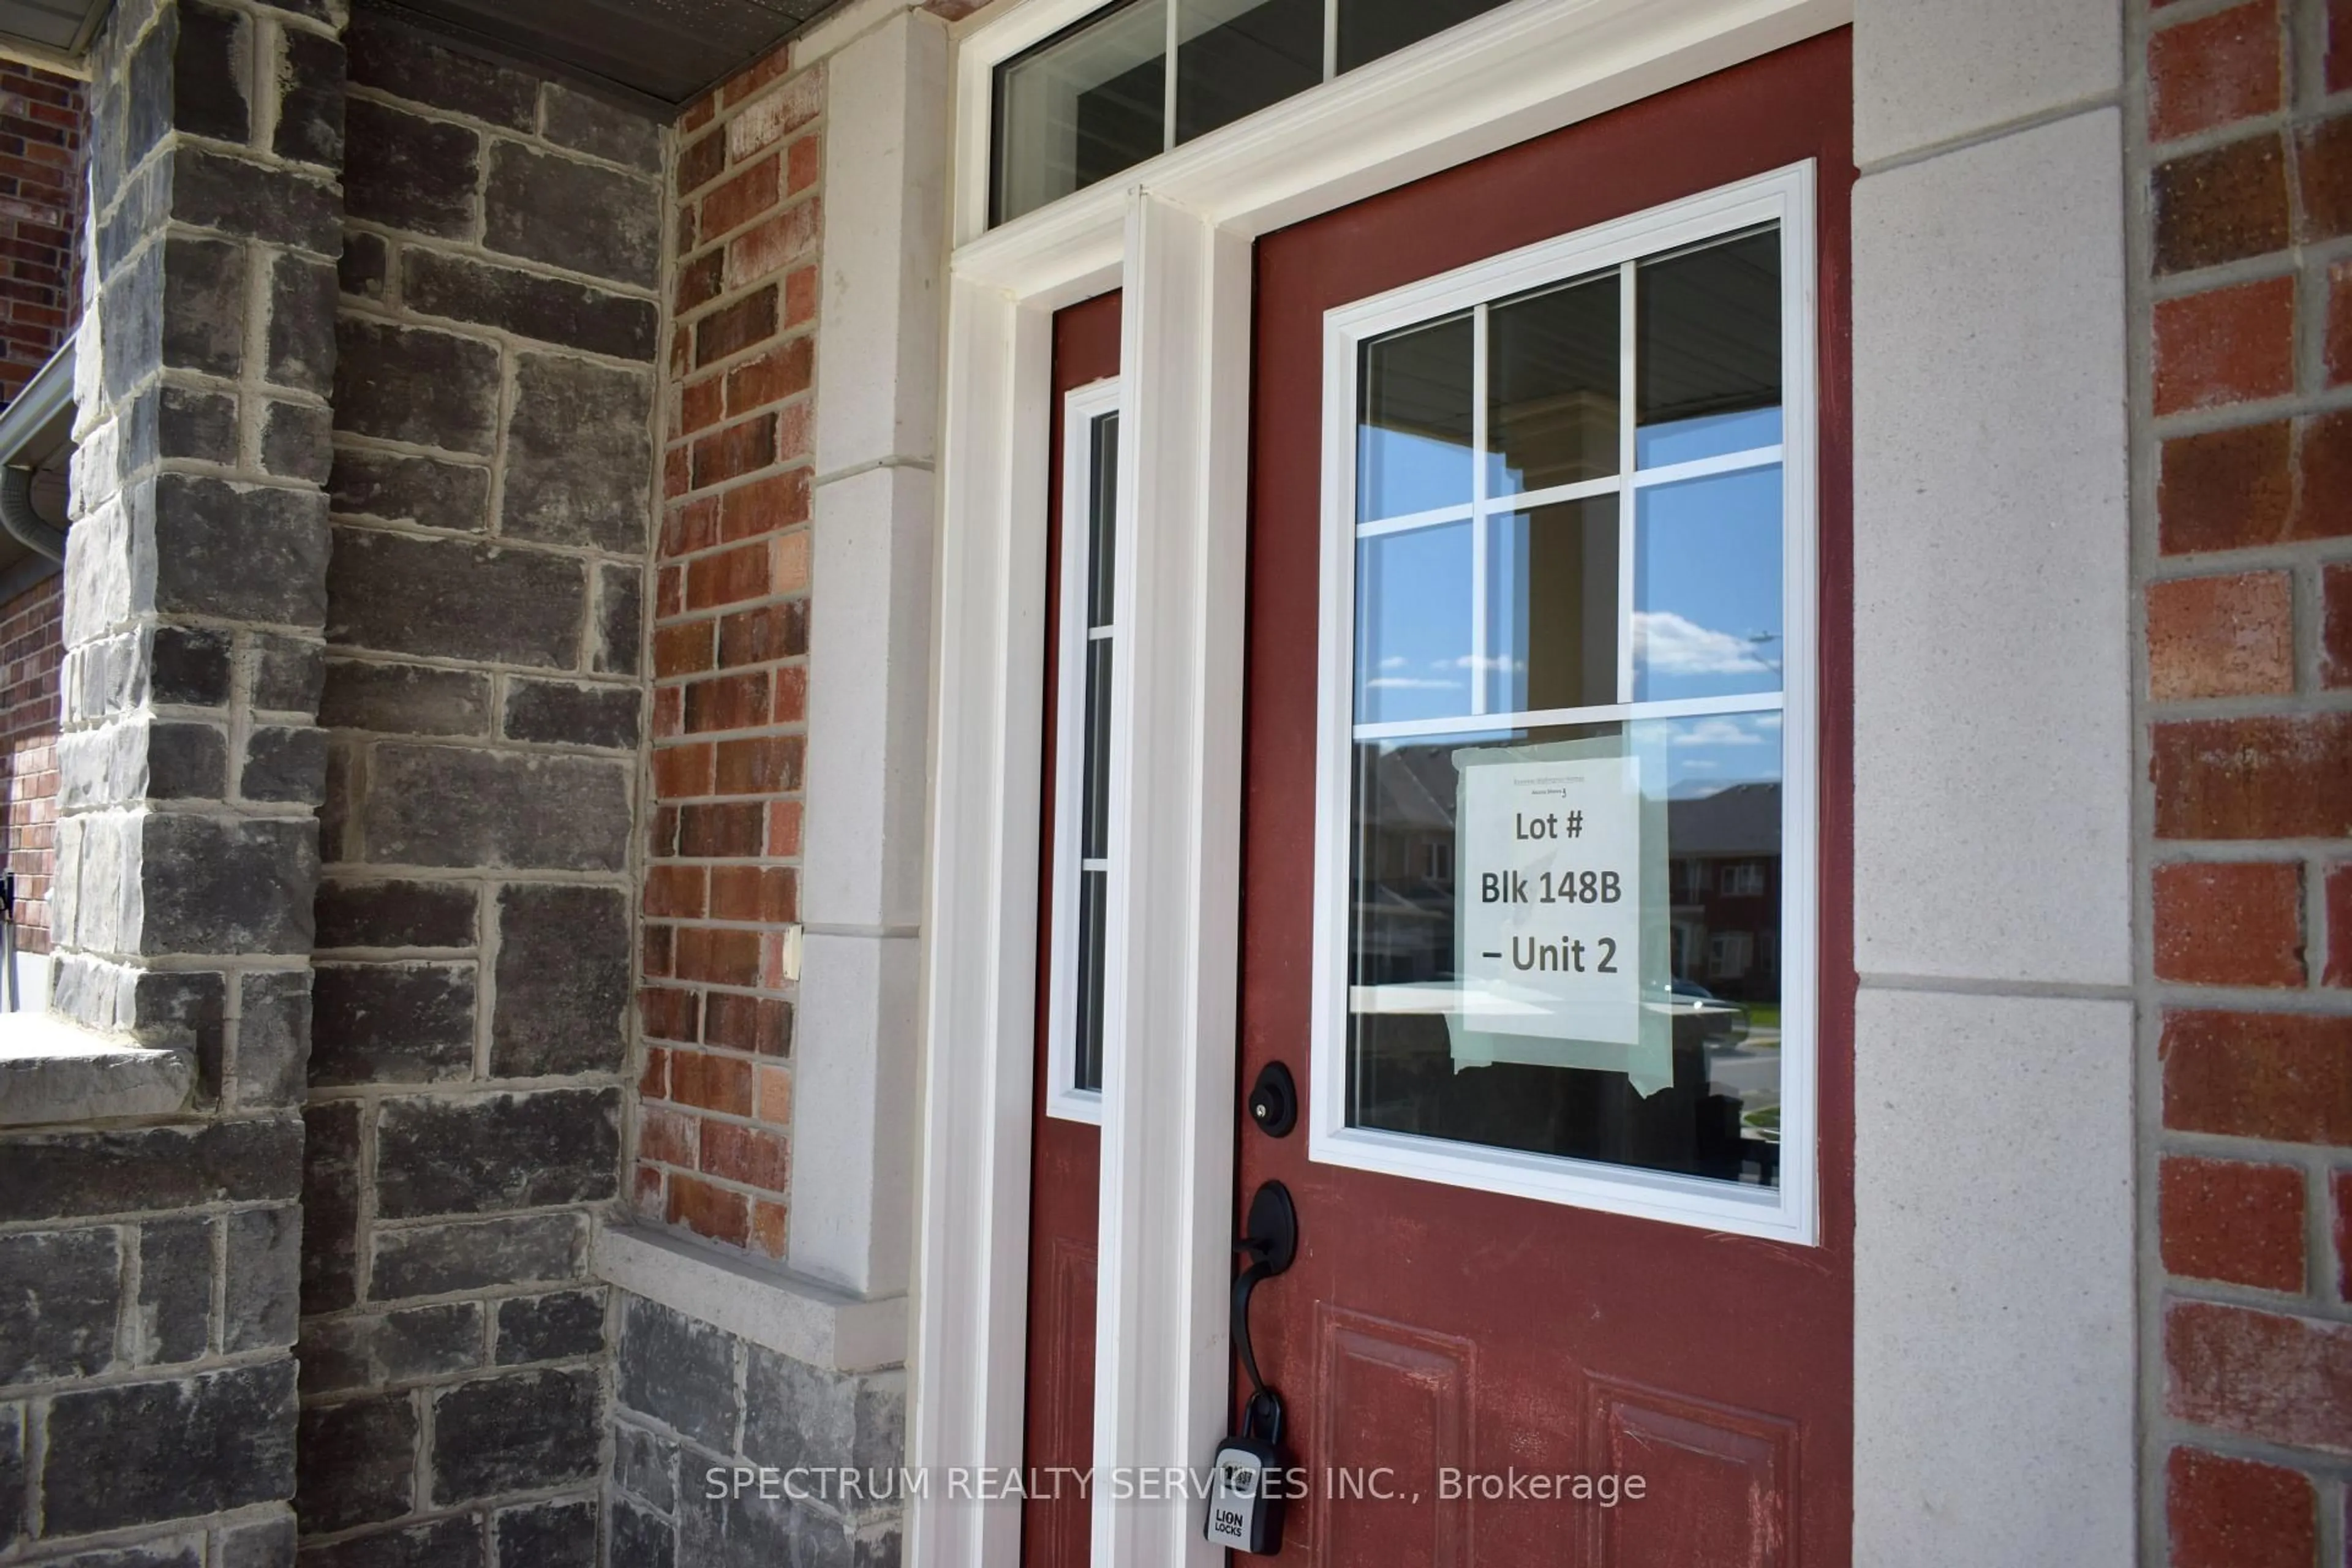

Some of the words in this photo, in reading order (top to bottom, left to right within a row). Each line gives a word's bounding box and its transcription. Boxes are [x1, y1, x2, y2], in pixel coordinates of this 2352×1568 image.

[1517, 813, 1558, 840] Lot
[1566, 810, 1583, 838] #
[1482, 870, 1528, 903] Blk
[1540, 871, 1621, 903] 148B
[1513, 936, 1585, 972] Unit
[1597, 938, 1618, 973] 2
[1215, 1523, 1242, 1537] LOCKS
[1216, 1509, 1243, 1527] LION
